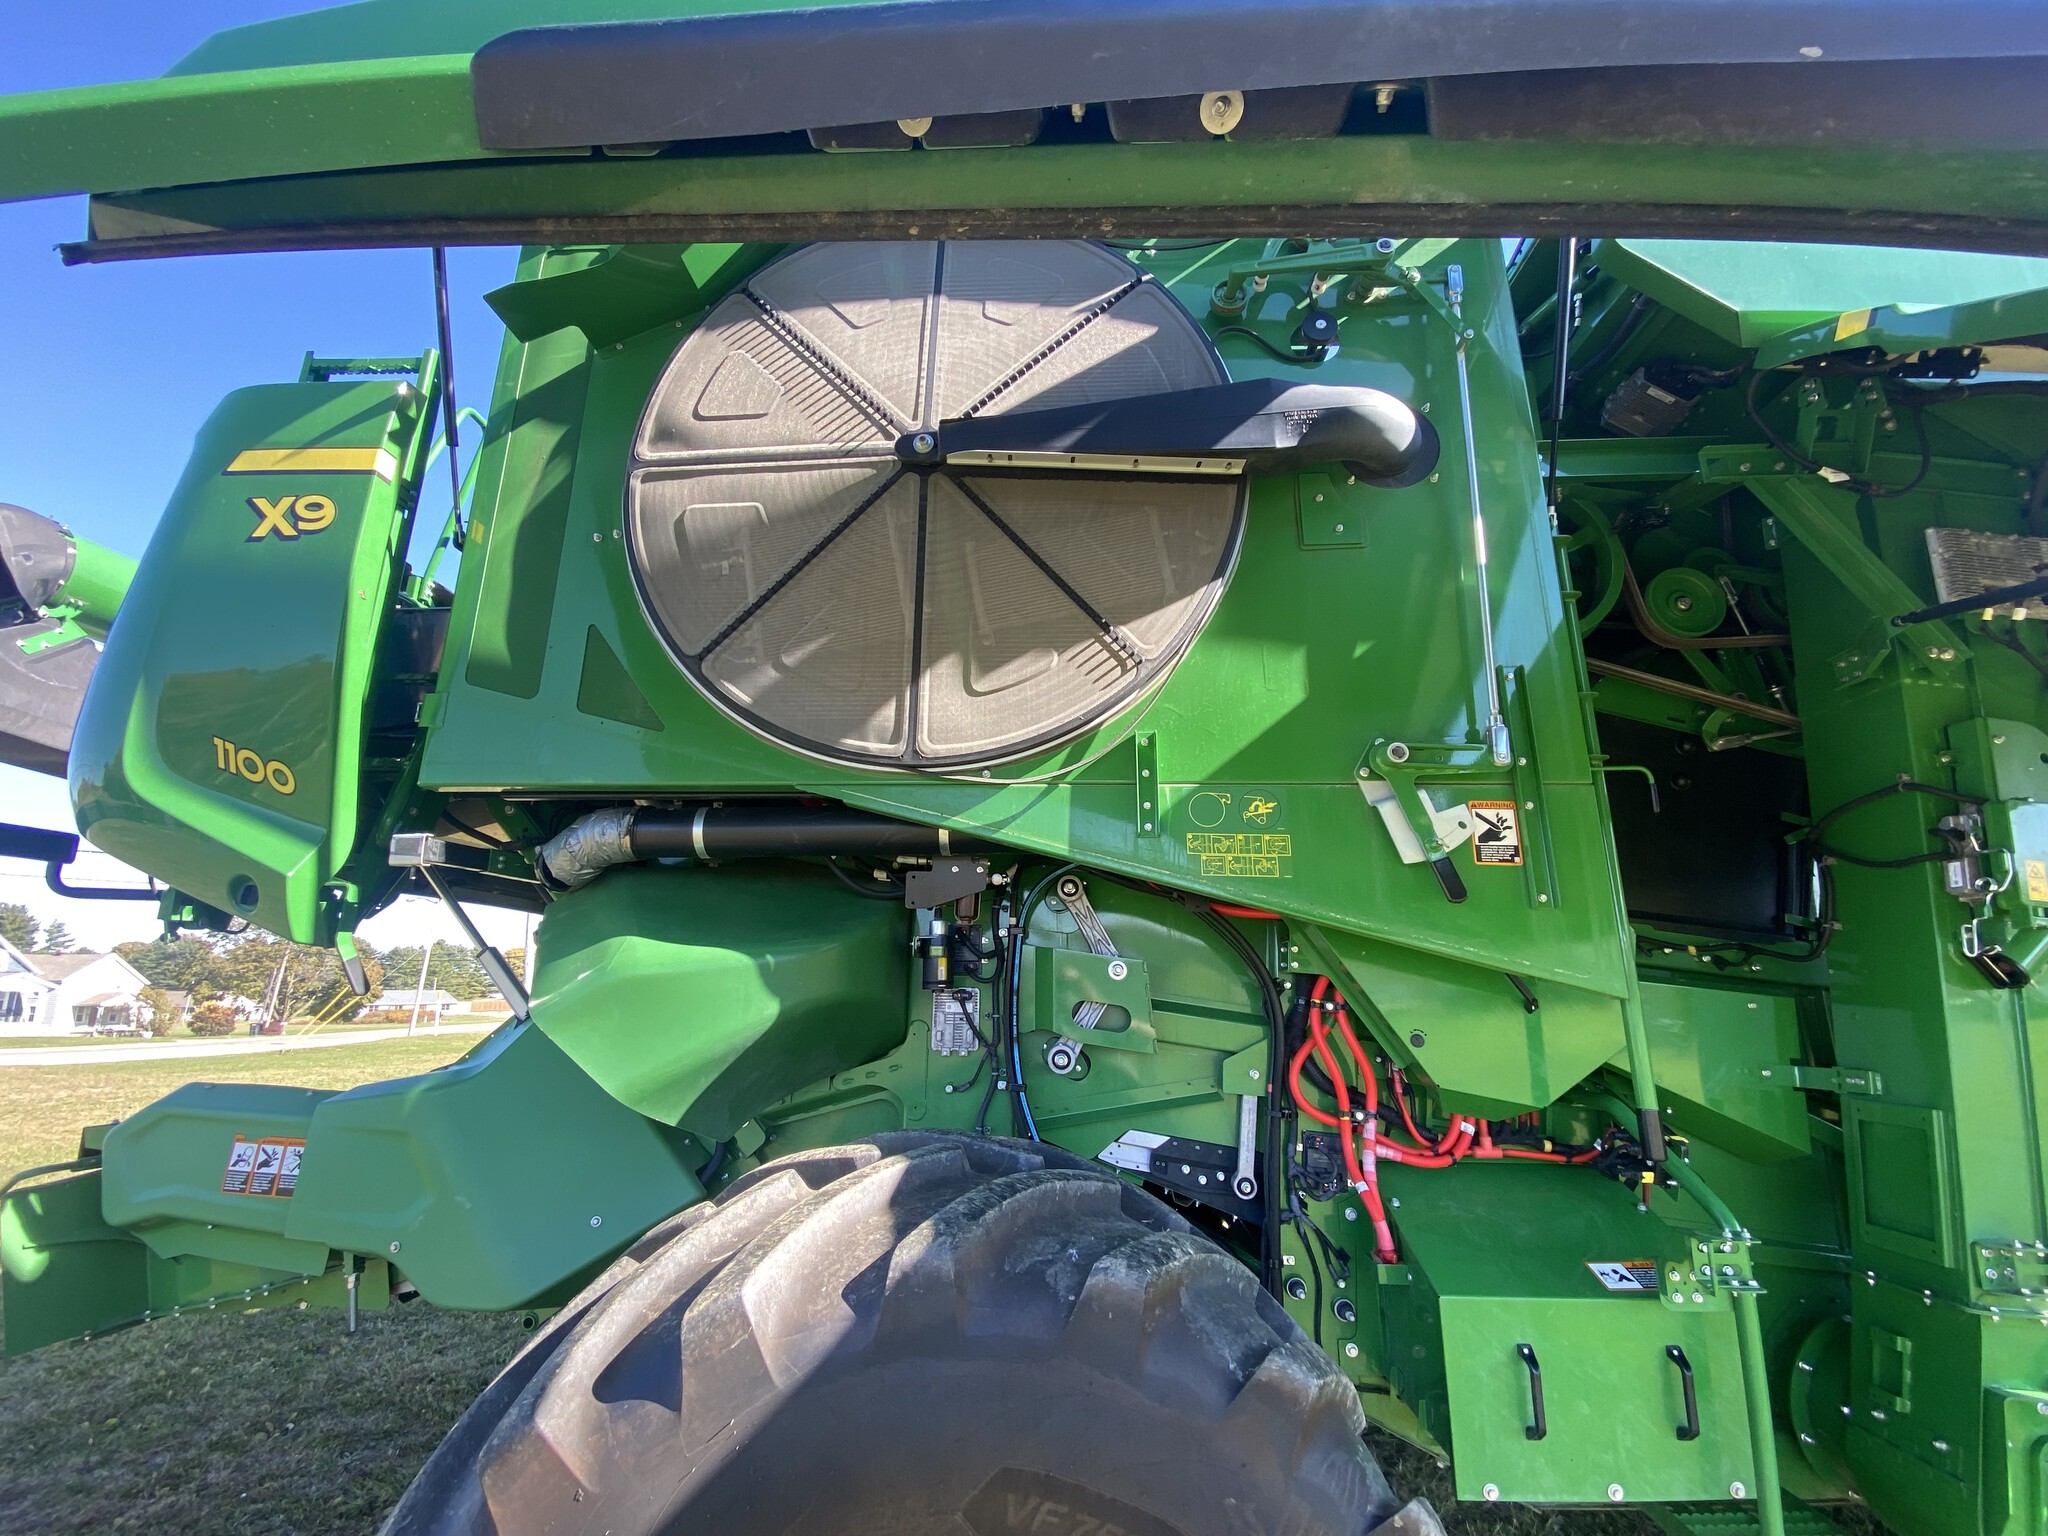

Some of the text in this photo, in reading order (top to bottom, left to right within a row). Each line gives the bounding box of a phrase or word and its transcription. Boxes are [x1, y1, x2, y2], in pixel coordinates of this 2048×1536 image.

[245, 494, 337, 543] X9
[212, 736, 297, 796] 1100
[1477, 801, 1515, 809] WARNING
